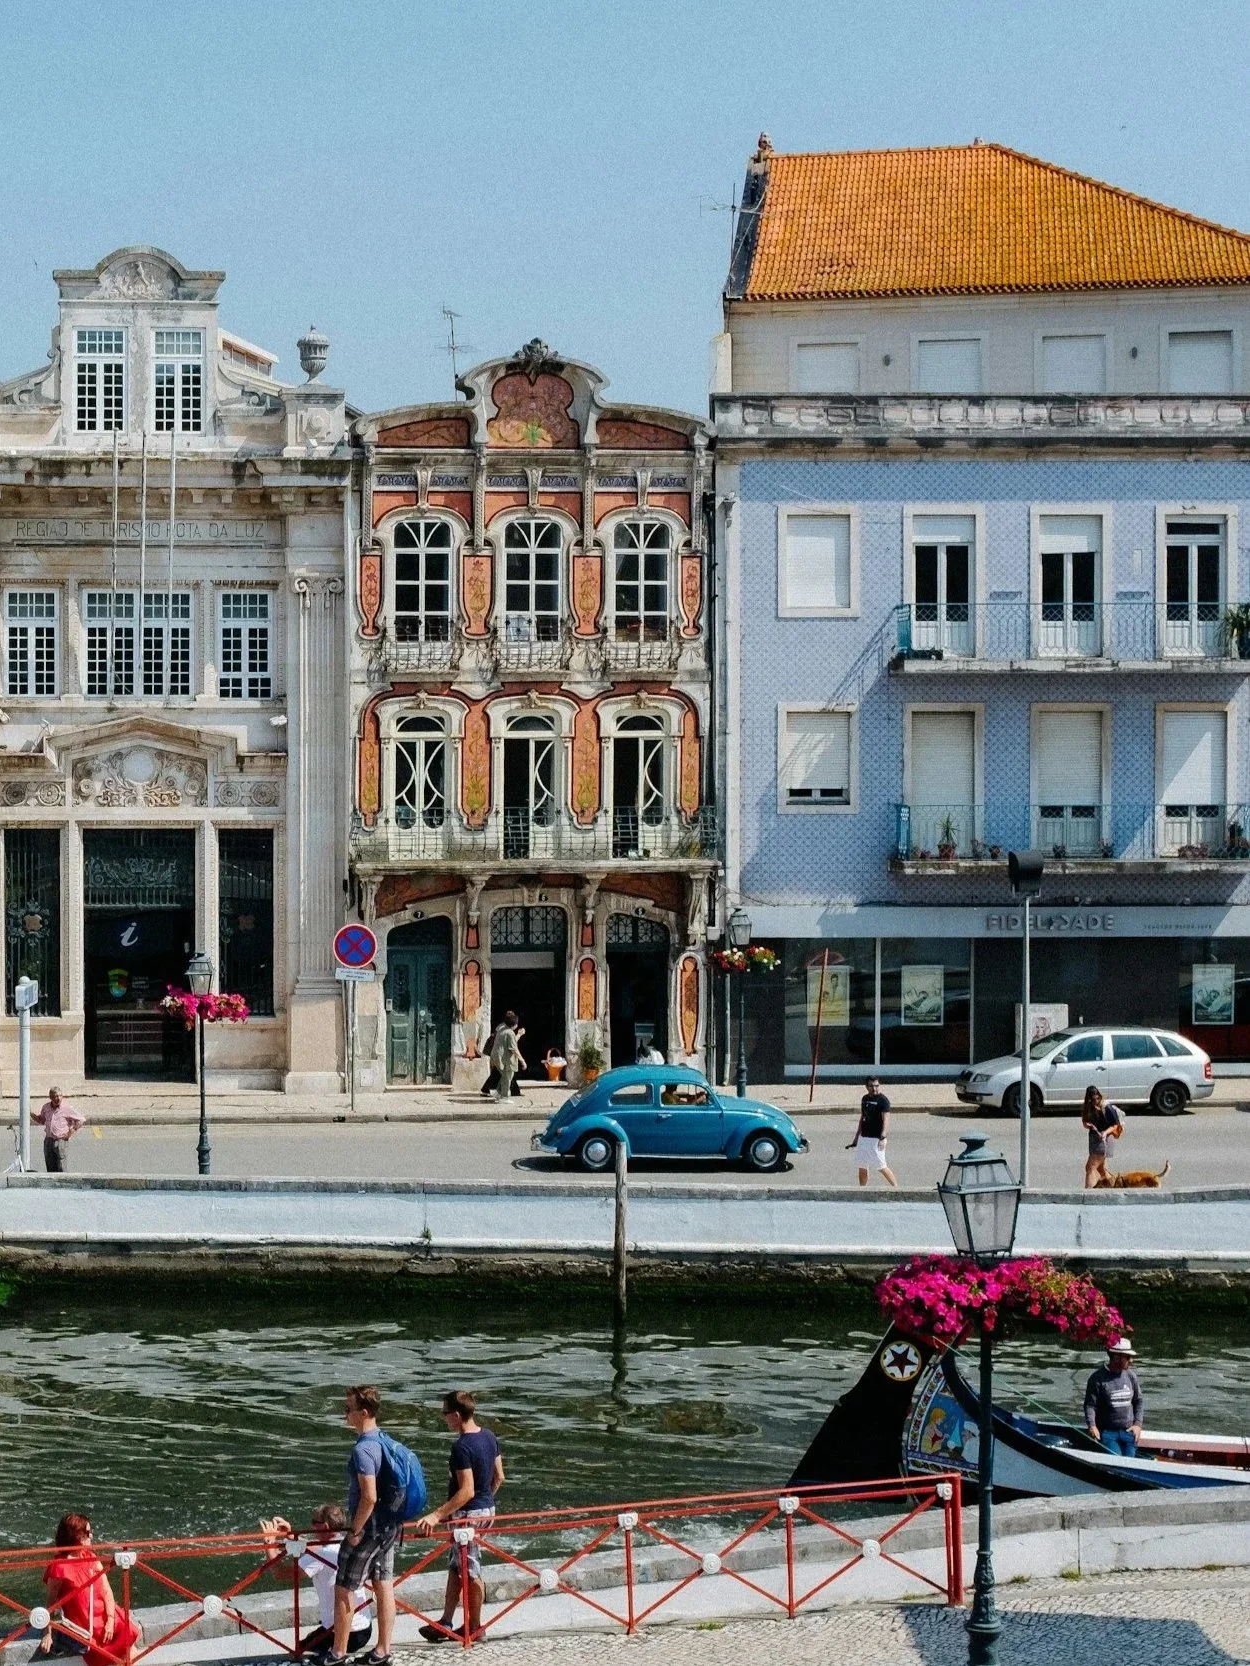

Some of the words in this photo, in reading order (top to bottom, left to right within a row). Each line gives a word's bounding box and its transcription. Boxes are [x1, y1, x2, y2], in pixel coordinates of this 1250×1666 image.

[75, 521, 93, 537] DE
[100, 522, 161, 538] TURISMO
[209, 522, 228, 538] DA
[235, 522, 265, 538] LUZ
